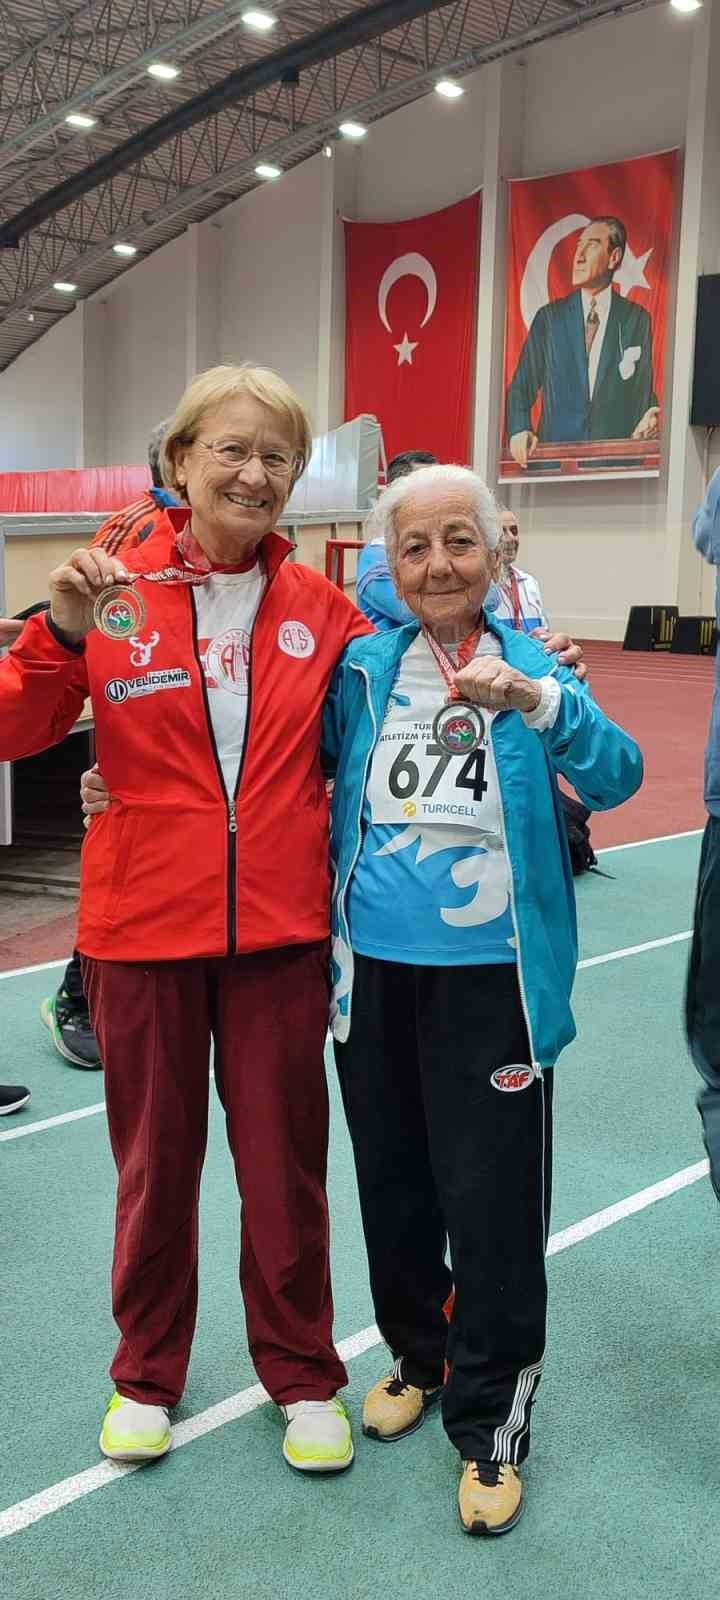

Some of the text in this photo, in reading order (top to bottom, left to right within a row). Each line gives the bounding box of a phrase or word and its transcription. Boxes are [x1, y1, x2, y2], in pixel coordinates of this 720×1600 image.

[388, 743, 488, 802] 674
[421, 803, 477, 817] TURKCELL
[495, 1071, 530, 1088] TAF
